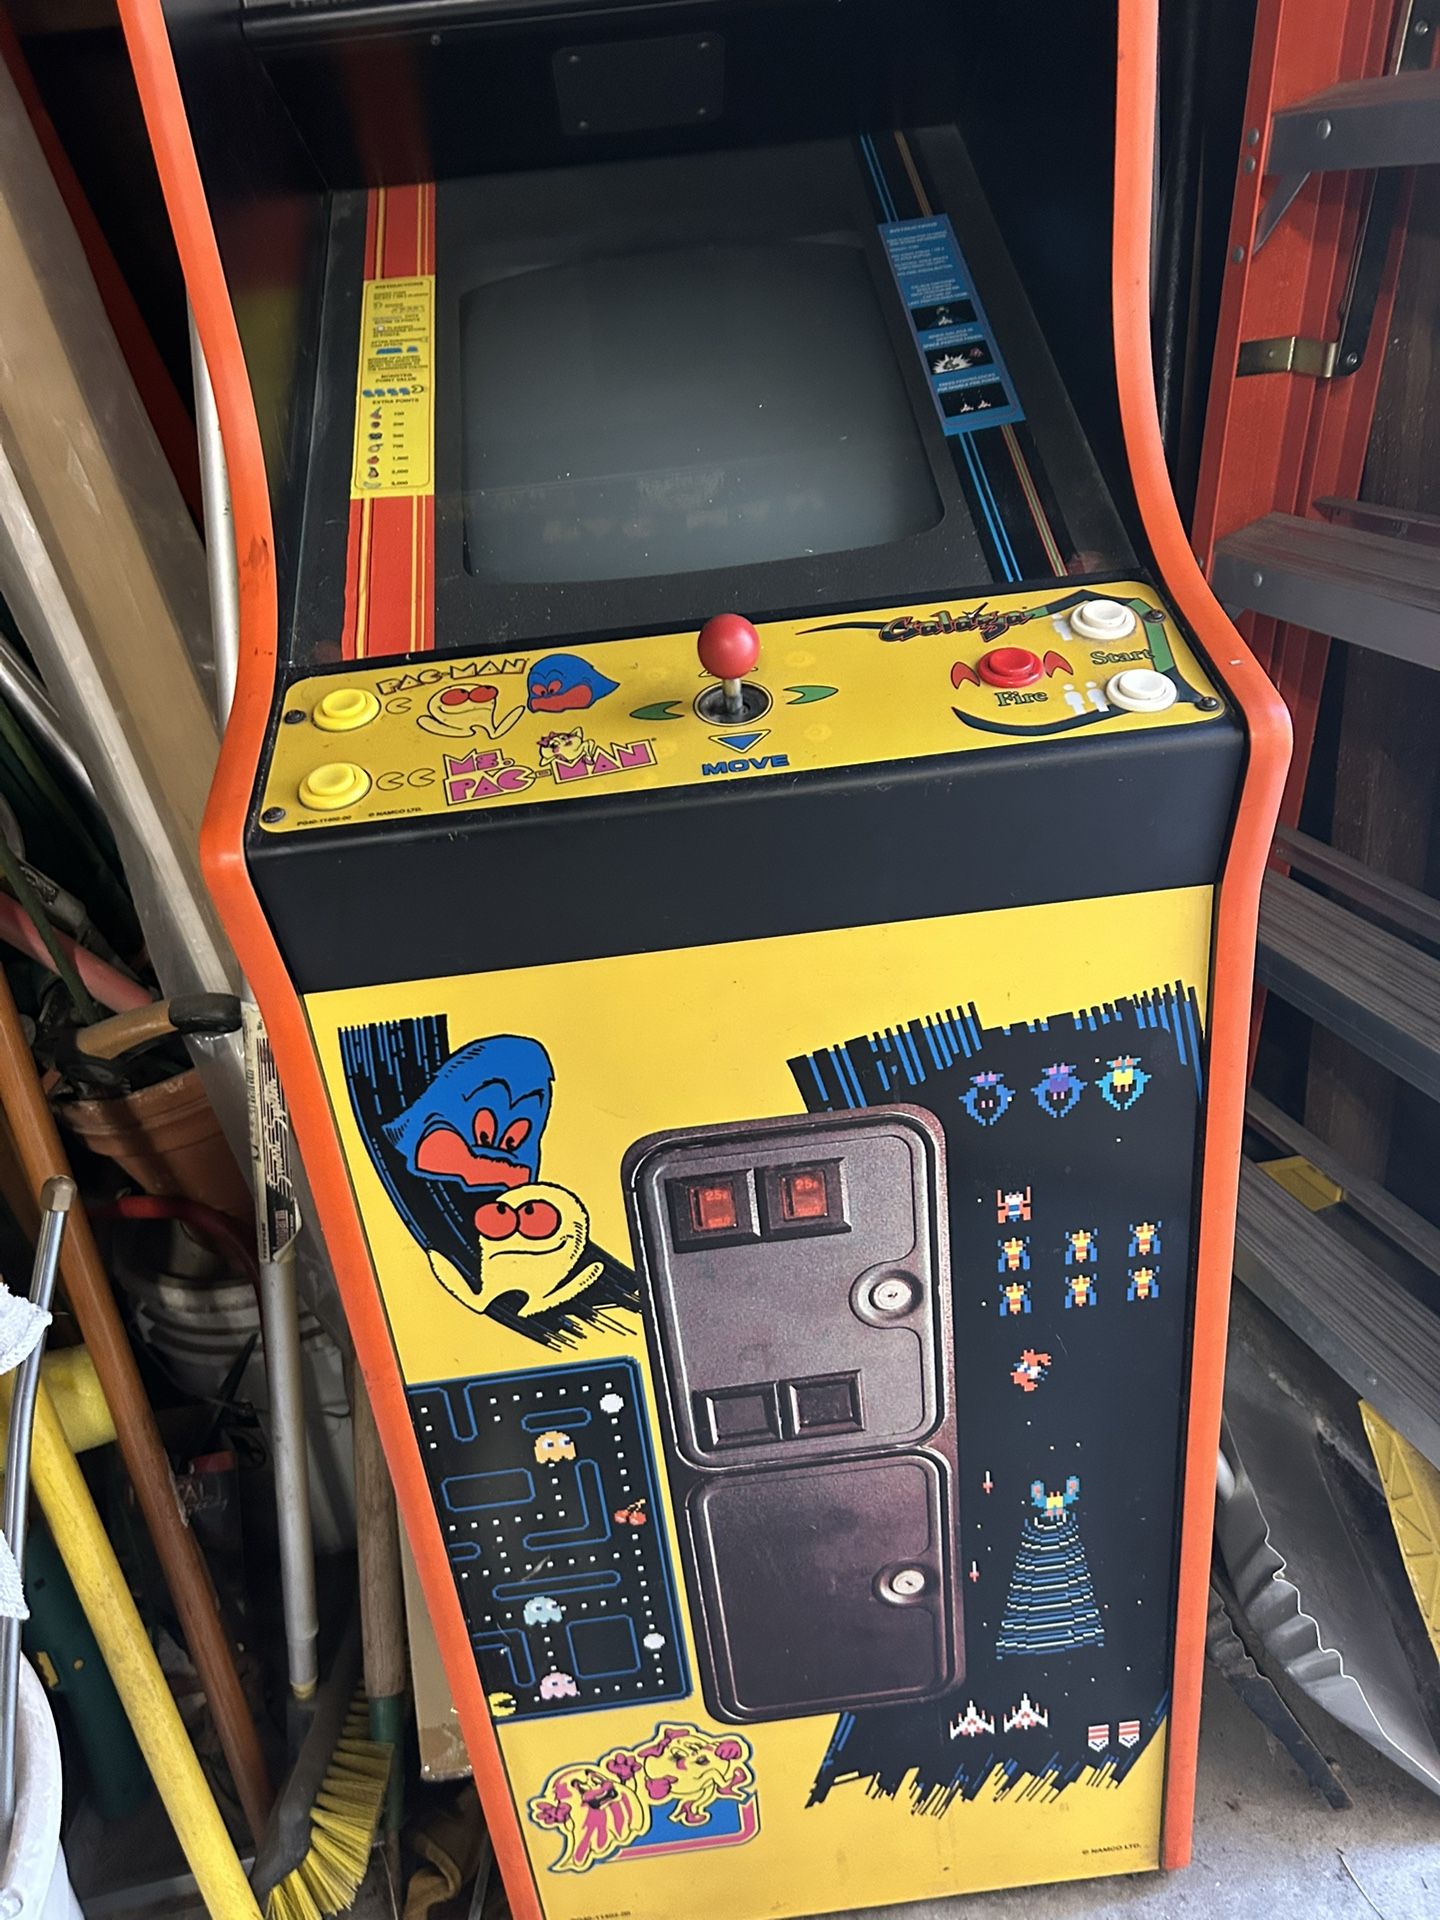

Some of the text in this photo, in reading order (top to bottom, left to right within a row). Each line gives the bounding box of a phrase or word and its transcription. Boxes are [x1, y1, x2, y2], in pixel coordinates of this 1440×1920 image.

[879, 609, 1036, 643] Galaga
[1091, 647, 1154, 665] Start
[376, 659, 527, 695] PAC-MAN
[994, 690, 1049, 706] Fire
[443, 739, 657, 806] PAC-MAN
[702, 754, 790, 776] MOVE
[376, 808, 405, 816] NAMCO
